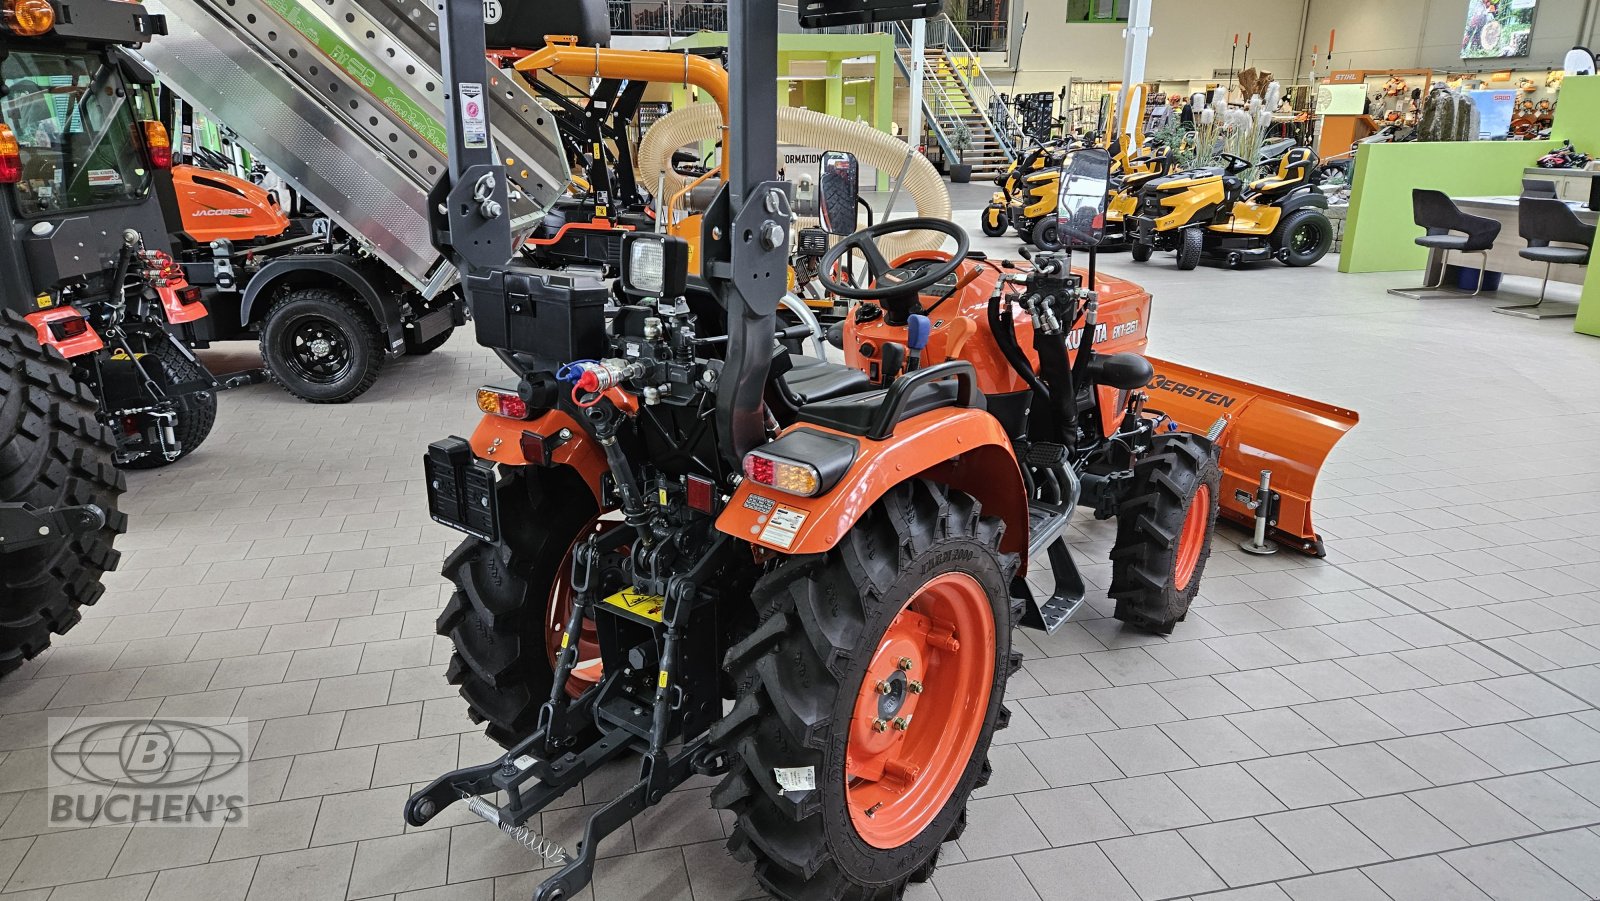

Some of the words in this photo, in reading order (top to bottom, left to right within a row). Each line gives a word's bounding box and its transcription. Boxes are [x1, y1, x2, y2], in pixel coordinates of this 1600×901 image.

[482, 2, 496, 18] 15
[784, 155, 822, 164] ORMATION
[192, 208, 254, 217] JACOBSEN
[1065, 323, 1107, 350] KUTA
[1146, 375, 1236, 408] KERSTEN
